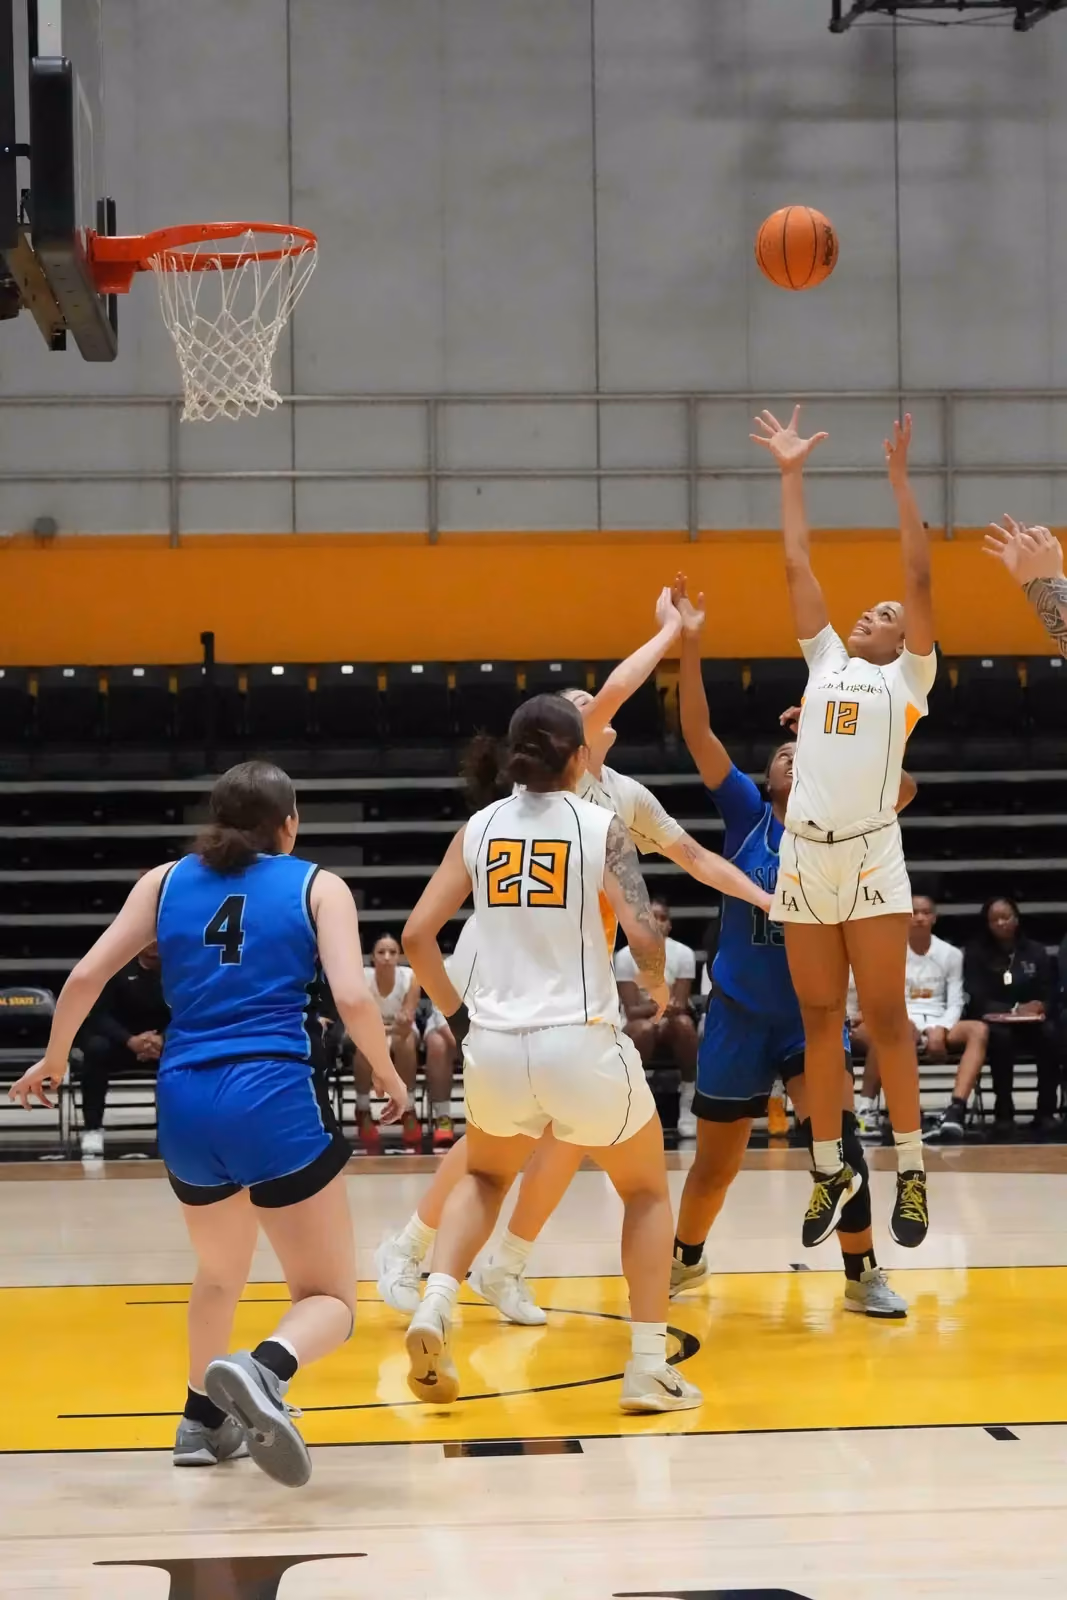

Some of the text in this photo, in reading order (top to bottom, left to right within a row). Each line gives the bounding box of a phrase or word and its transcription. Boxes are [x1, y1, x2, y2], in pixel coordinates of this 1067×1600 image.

[834, 680, 883, 695] Angeles
[824, 700, 859, 736] 12
[781, 890, 800, 911] LA
[863, 886, 886, 905] LA
[203, 893, 248, 966] 4
